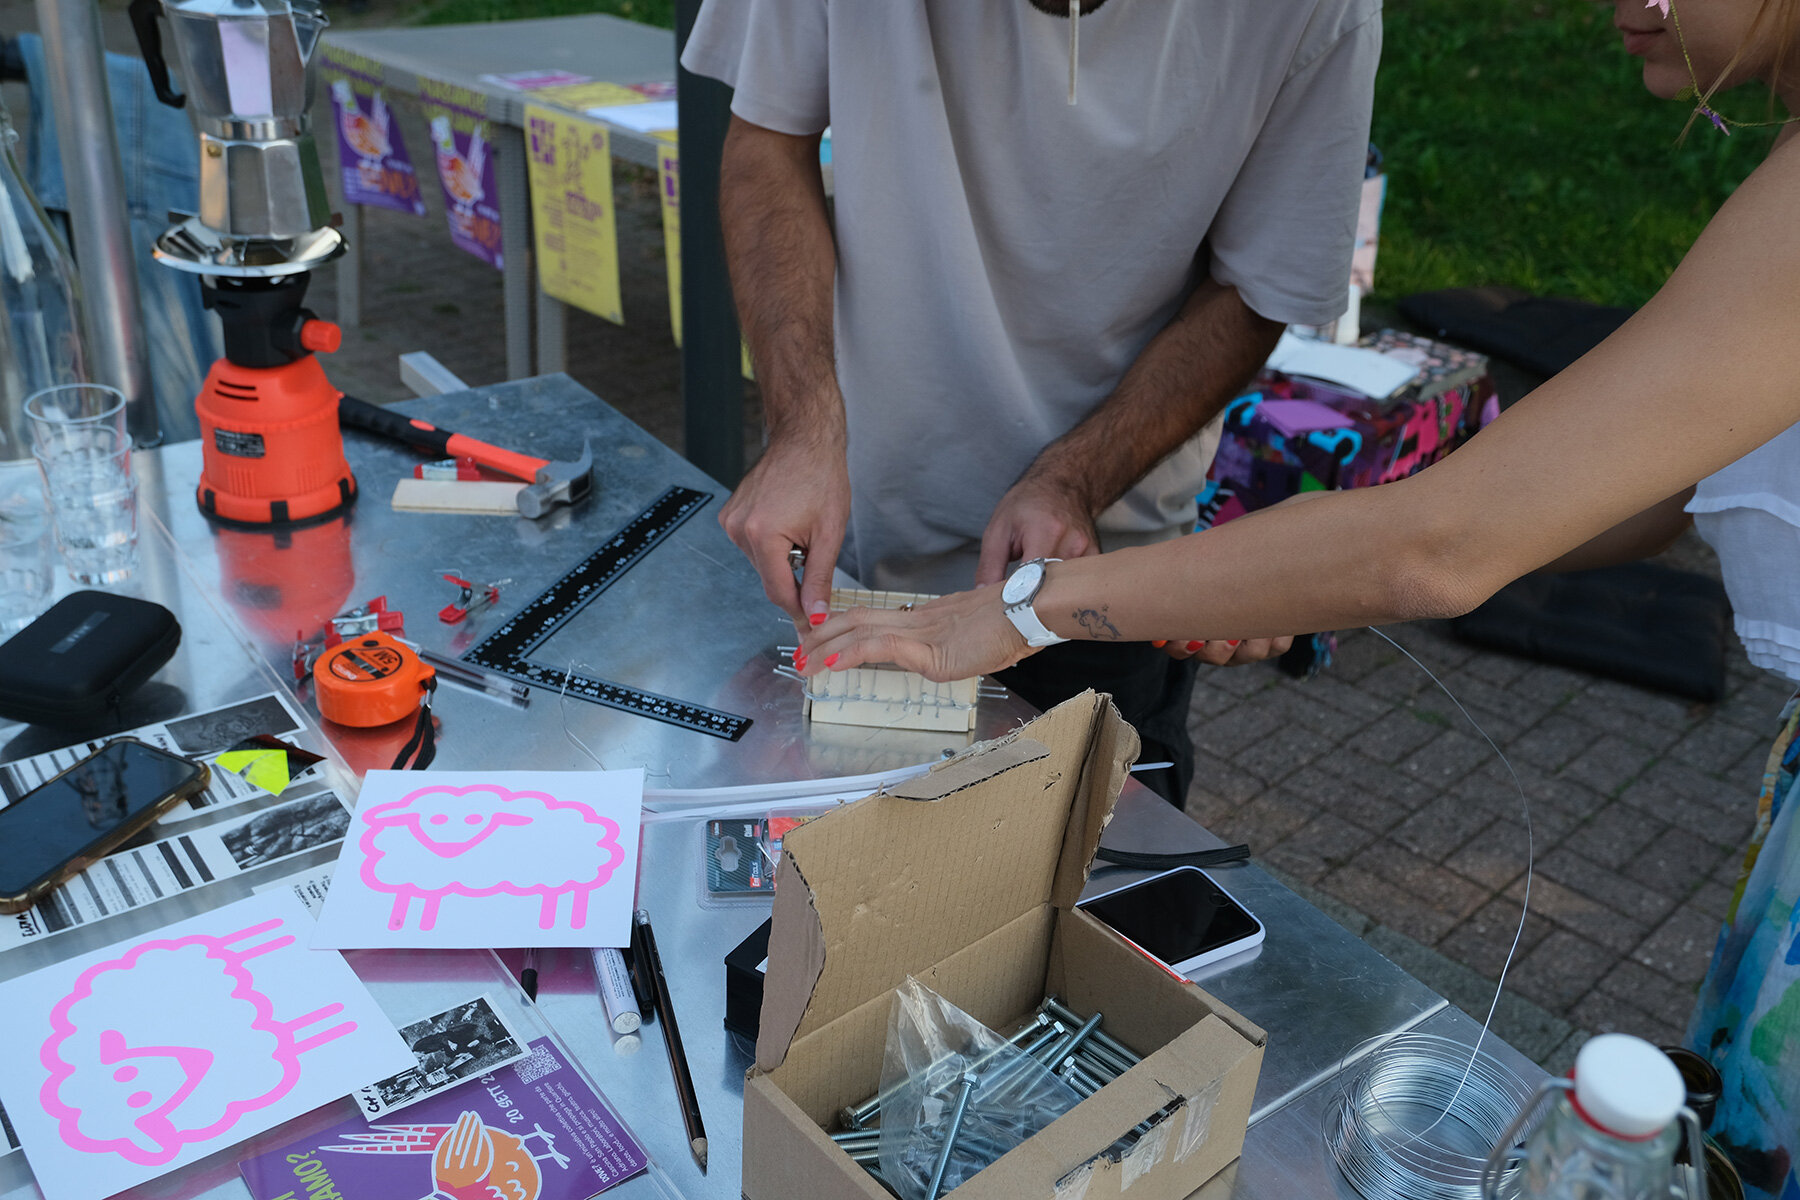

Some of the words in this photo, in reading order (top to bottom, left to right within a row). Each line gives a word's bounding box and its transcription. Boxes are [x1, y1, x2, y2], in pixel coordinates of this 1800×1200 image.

[486, 1085, 513, 1108] SETT
[539, 1092, 552, 1104] parte
[544, 1082, 562, 1103] Quartiere
[548, 1103, 558, 1113] che
[505, 1109, 524, 1123] 20
[555, 1112, 573, 1133] collettiva
[598, 1120, 611, 1134] molto
[584, 1133, 597, 1148] Paolo
[594, 1146, 604, 1158] San
[591, 1164, 610, 1183] DOVE?
[602, 1156, 619, 1177] Cascina
